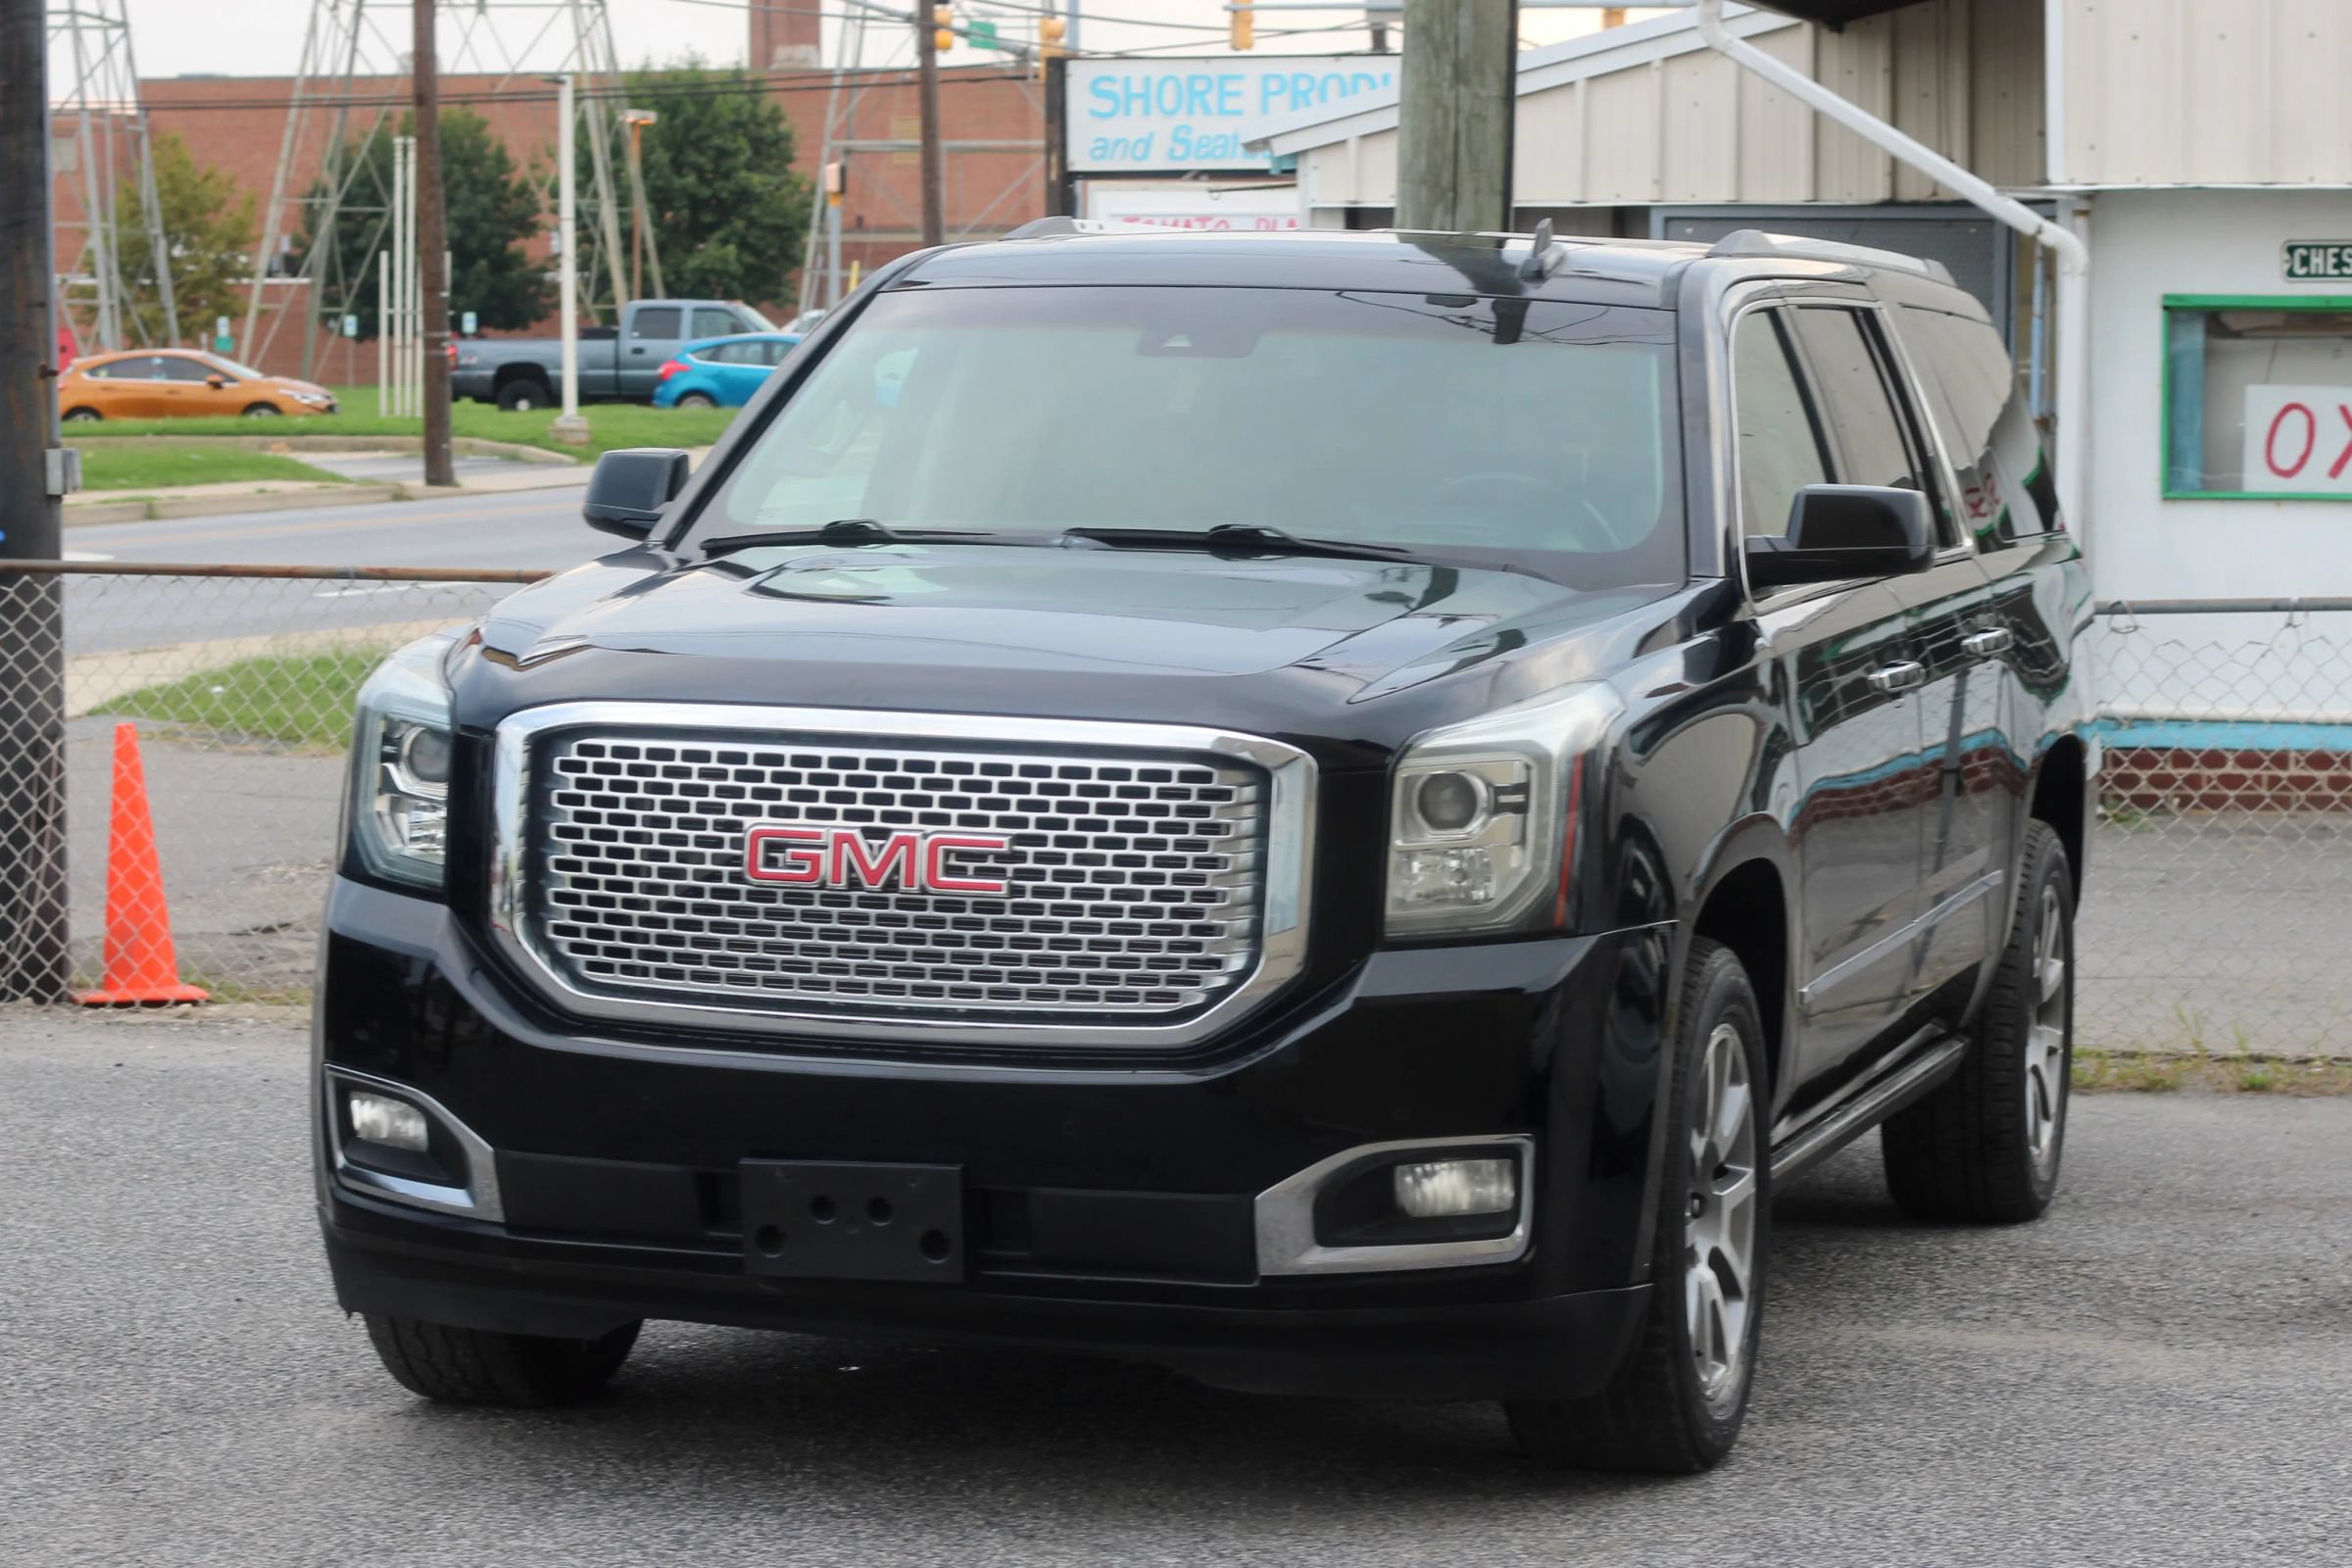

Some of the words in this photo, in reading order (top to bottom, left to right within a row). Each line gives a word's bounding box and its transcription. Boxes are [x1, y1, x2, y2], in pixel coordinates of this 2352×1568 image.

[1089, 74, 1245, 119] SHORE
[1089, 131, 1155, 162] and
[2293, 248, 2352, 275] CHES
[745, 824, 1012, 898] GMC
